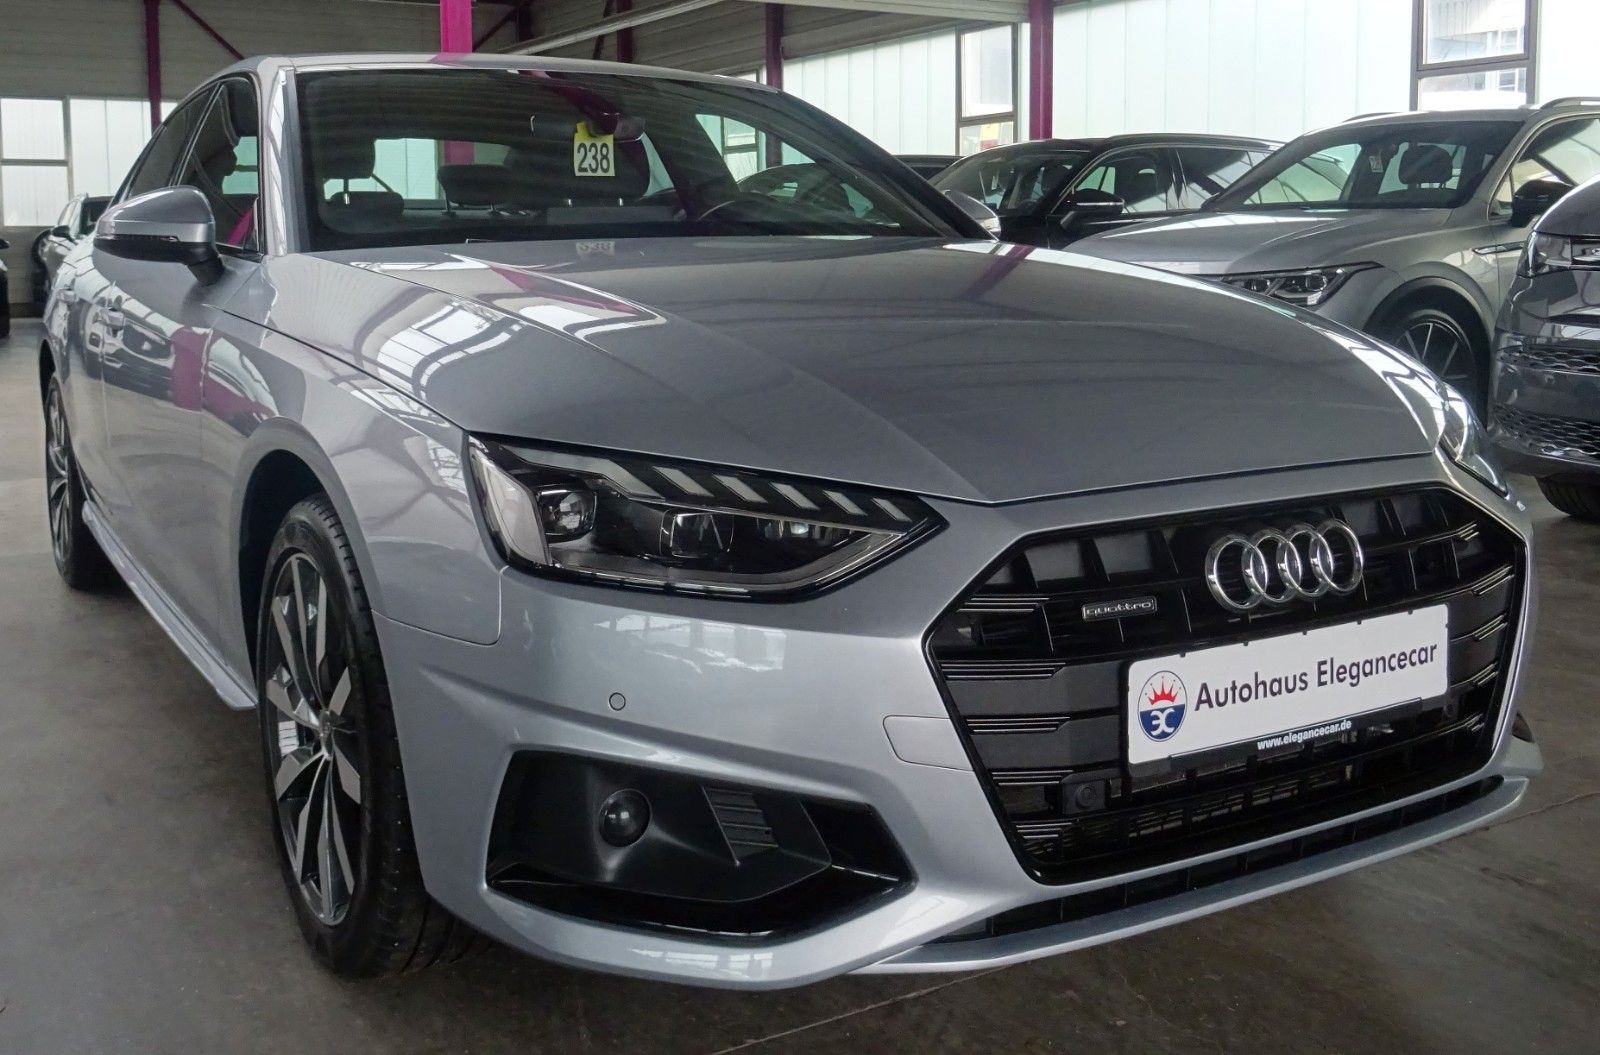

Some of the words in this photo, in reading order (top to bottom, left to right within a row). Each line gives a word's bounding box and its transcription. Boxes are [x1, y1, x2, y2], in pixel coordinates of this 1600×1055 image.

[577, 142, 611, 174] 238
[1086, 601, 1152, 617] quattro
[1194, 671, 1309, 712] Autohaus
[1316, 643, 1438, 688] Elegancecar
[1256, 719, 1353, 751] www.elegancecar.de
